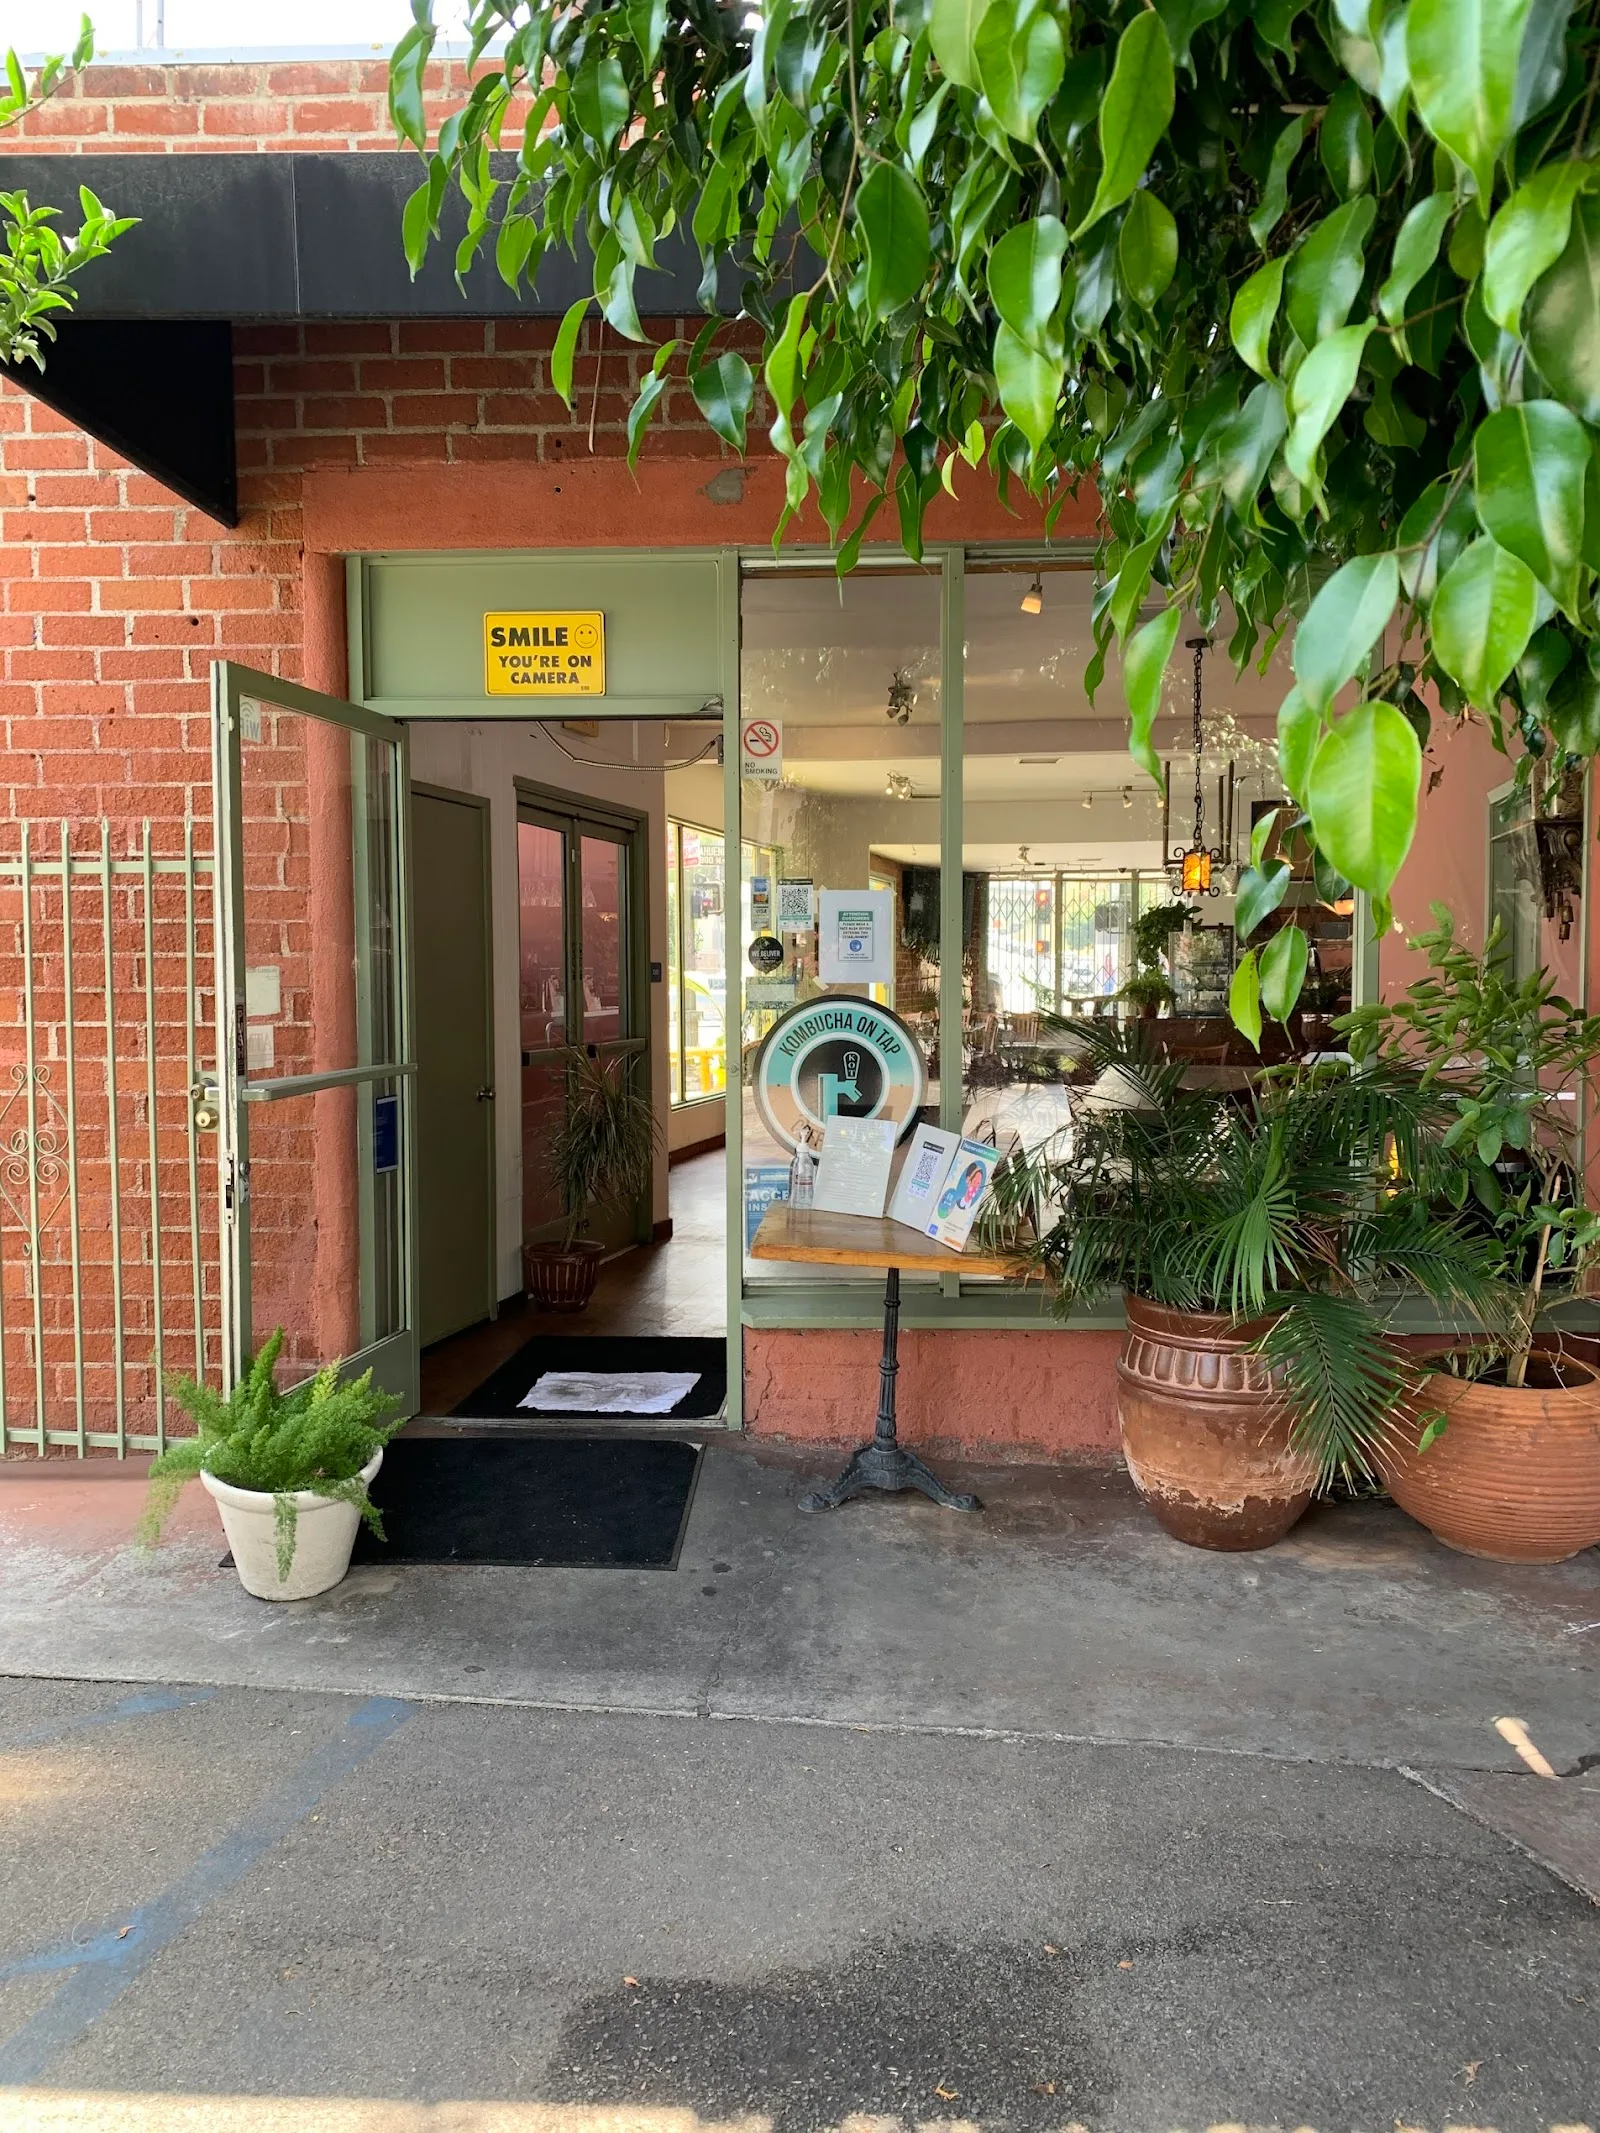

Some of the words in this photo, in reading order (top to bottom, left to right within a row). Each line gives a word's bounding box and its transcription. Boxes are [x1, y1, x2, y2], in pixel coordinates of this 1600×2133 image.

[491, 627, 568, 647] SMILE
[499, 654, 560, 668] YOU'RE
[567, 655, 592, 668] ON
[510, 672, 580, 684] CAMERA
[779, 1012, 853, 1057] KOMBUCHA
[856, 1016, 879, 1038] ON
[875, 1028, 901, 1054] TAP
[848, 1054, 856, 1076] KOT
